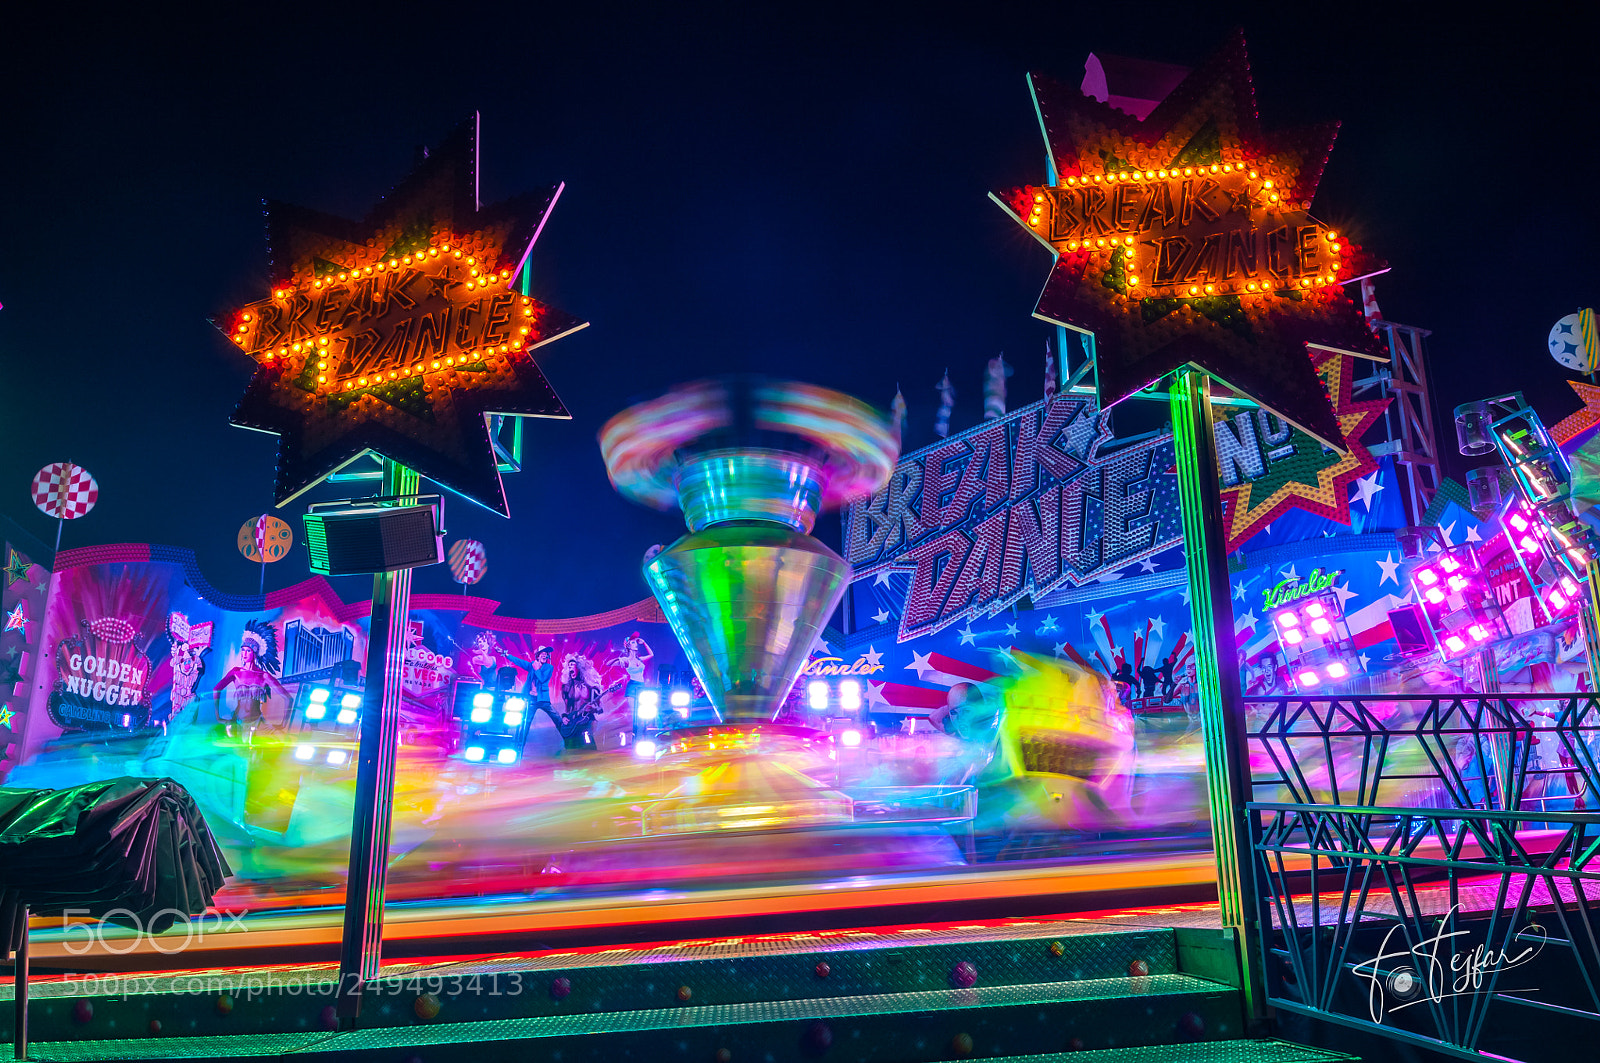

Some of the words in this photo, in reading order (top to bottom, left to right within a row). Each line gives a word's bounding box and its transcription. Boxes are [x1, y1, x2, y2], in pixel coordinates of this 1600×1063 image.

[1046, 178, 1221, 242] BREAK
[1141, 224, 1323, 286] DANCE
[252, 269, 424, 351] BREAK
[334, 290, 518, 380] DANCE
[848, 397, 1090, 566] BREAK
[896, 446, 1158, 632] DANCE
[66, 675, 142, 706] NUGGET
[69, 653, 144, 685] GOLDEN
[414, 668, 450, 685] VEGAS
[58, 703, 111, 724] GAMBLING
